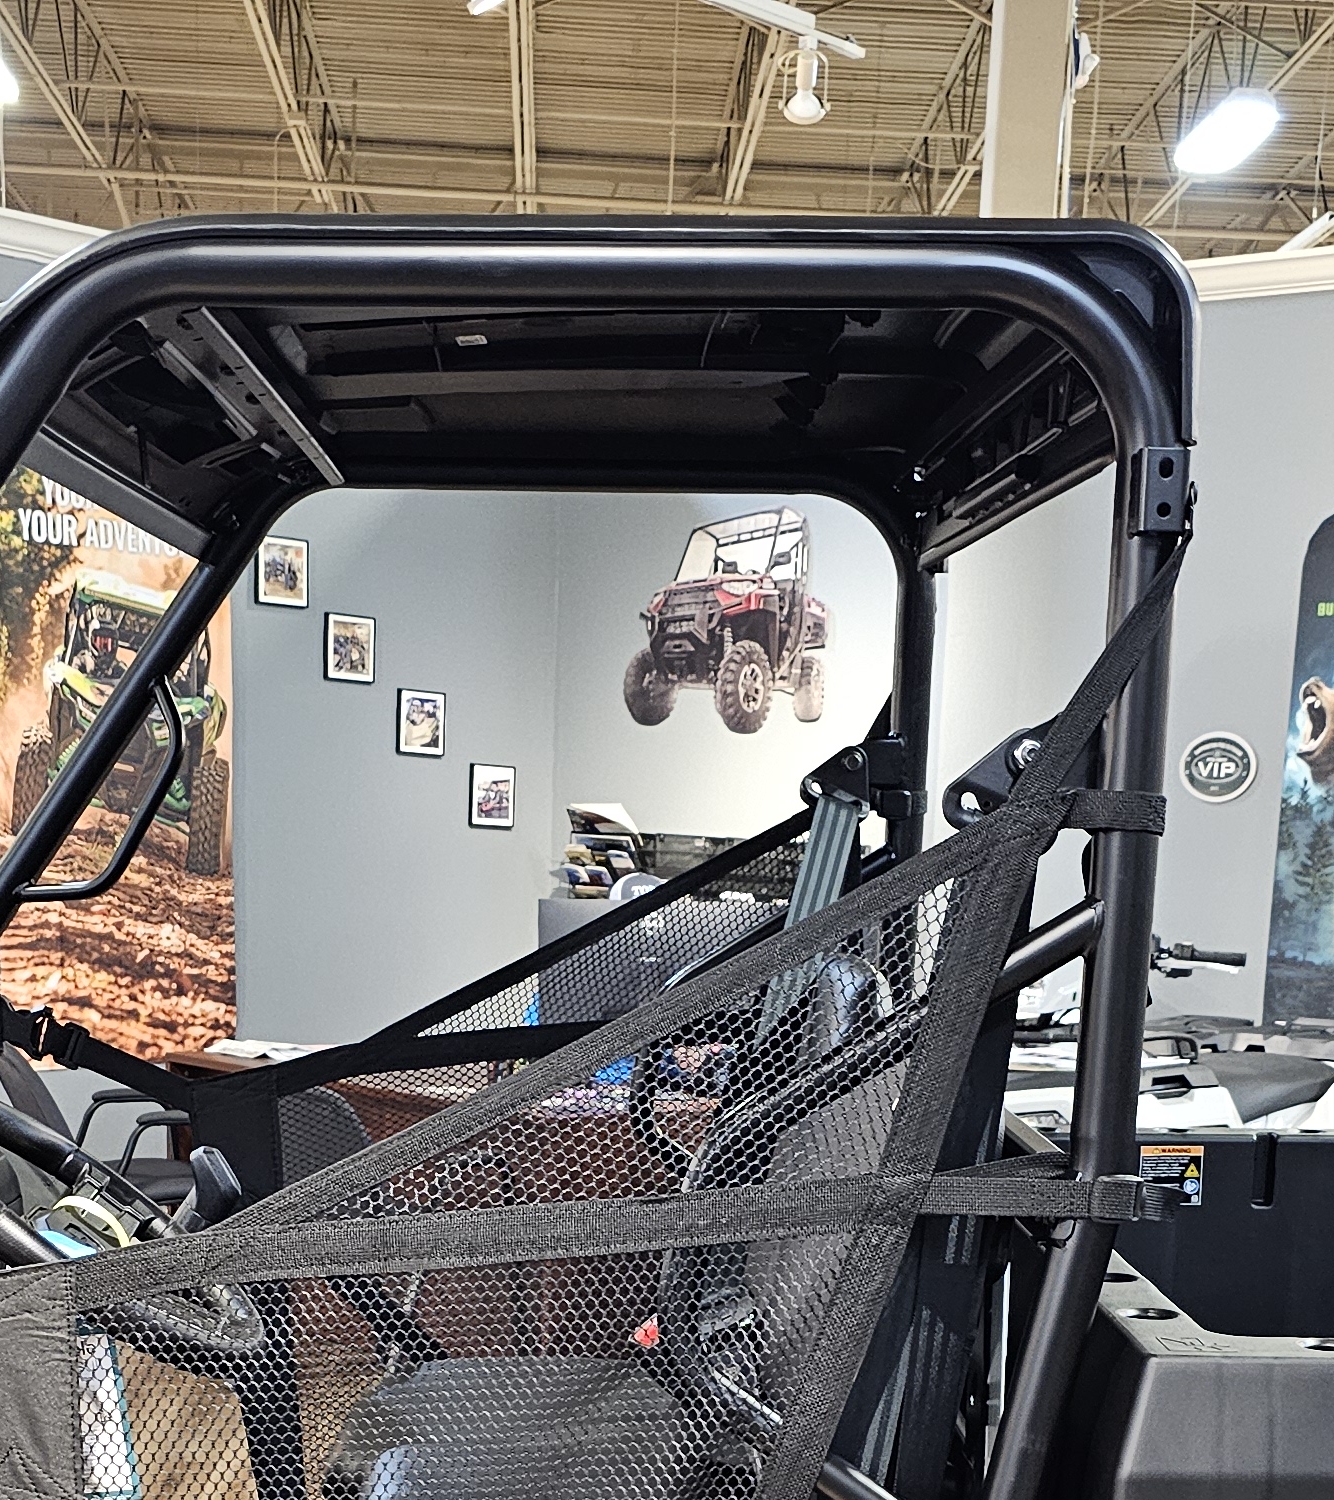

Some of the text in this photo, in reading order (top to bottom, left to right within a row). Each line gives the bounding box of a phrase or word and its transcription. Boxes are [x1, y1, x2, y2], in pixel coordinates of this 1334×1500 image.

[41, 476, 97, 510] YO
[18, 508, 79, 547] YOUR
[1197, 760, 1237, 778] VIP
